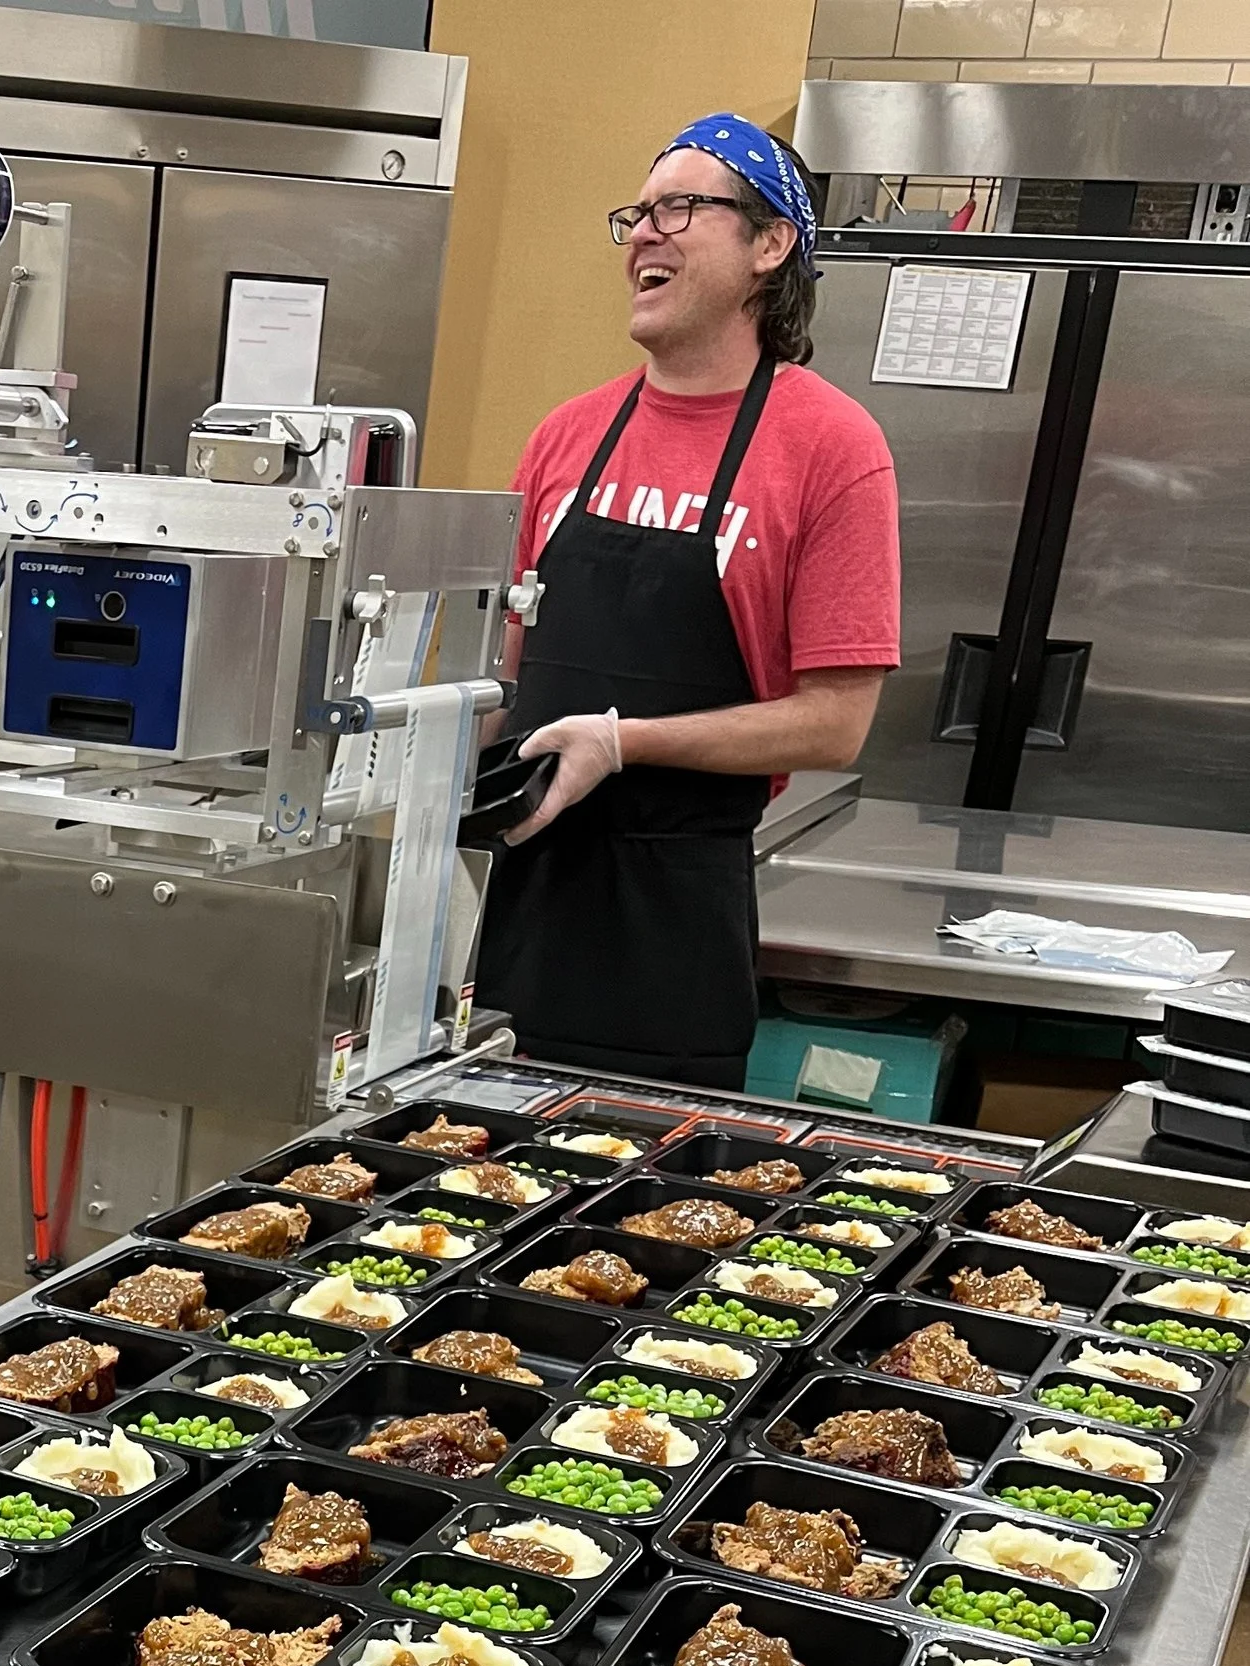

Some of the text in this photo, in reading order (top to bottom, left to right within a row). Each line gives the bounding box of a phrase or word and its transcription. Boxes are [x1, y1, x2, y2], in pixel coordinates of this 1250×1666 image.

[69, 480, 78, 490] 7
[292, 512, 304, 528] 8
[44, 563, 85, 576] DataFlex
[114, 569, 175, 584] VIDEOJET
